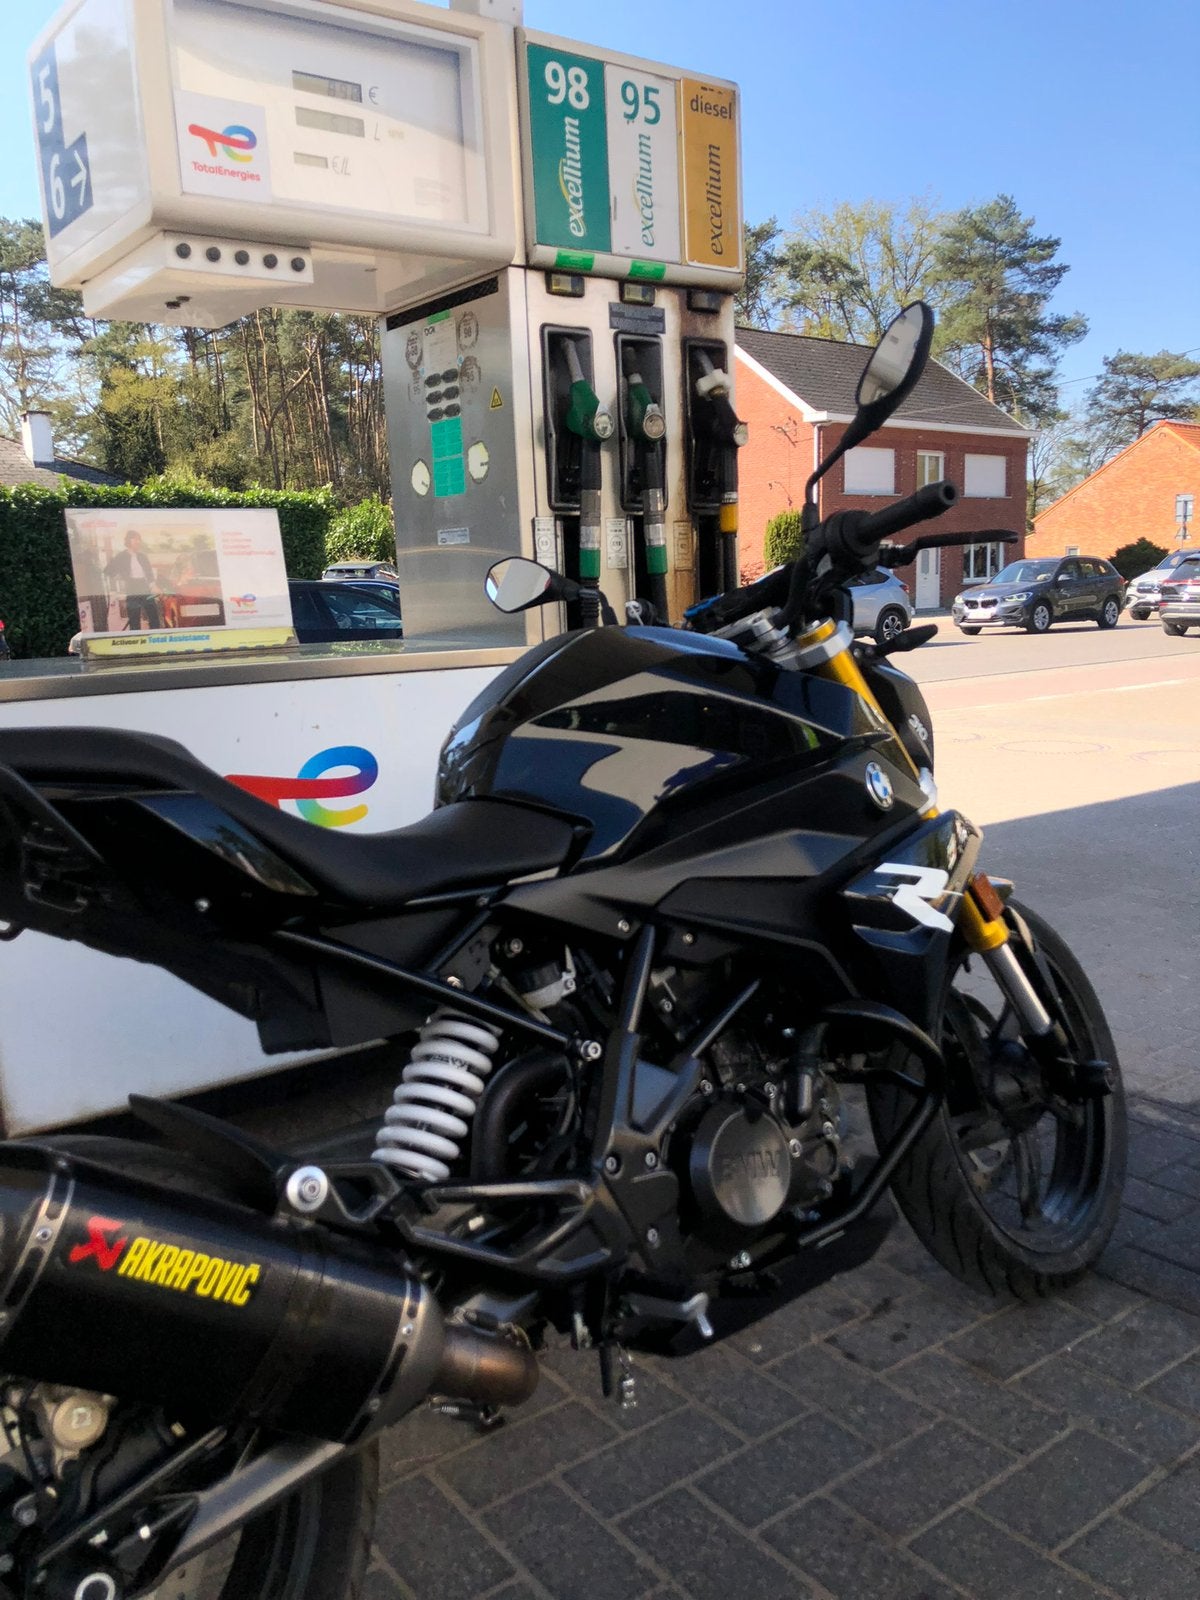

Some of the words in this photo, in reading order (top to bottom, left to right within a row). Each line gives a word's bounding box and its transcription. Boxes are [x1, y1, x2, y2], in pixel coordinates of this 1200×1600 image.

[38, 64, 55, 134] 5
[545, 60, 590, 110] 98
[620, 80, 661, 125] 95
[690, 94, 732, 120] diesel
[50, 153, 66, 219] 6
[191, 160, 261, 181] TotalEnergies
[562, 116, 585, 237] excellium
[636, 133, 655, 247] excellium
[706, 143, 724, 255] excellium
[169, 634, 210, 642] Assistance
[908, 713, 929, 741] 310
